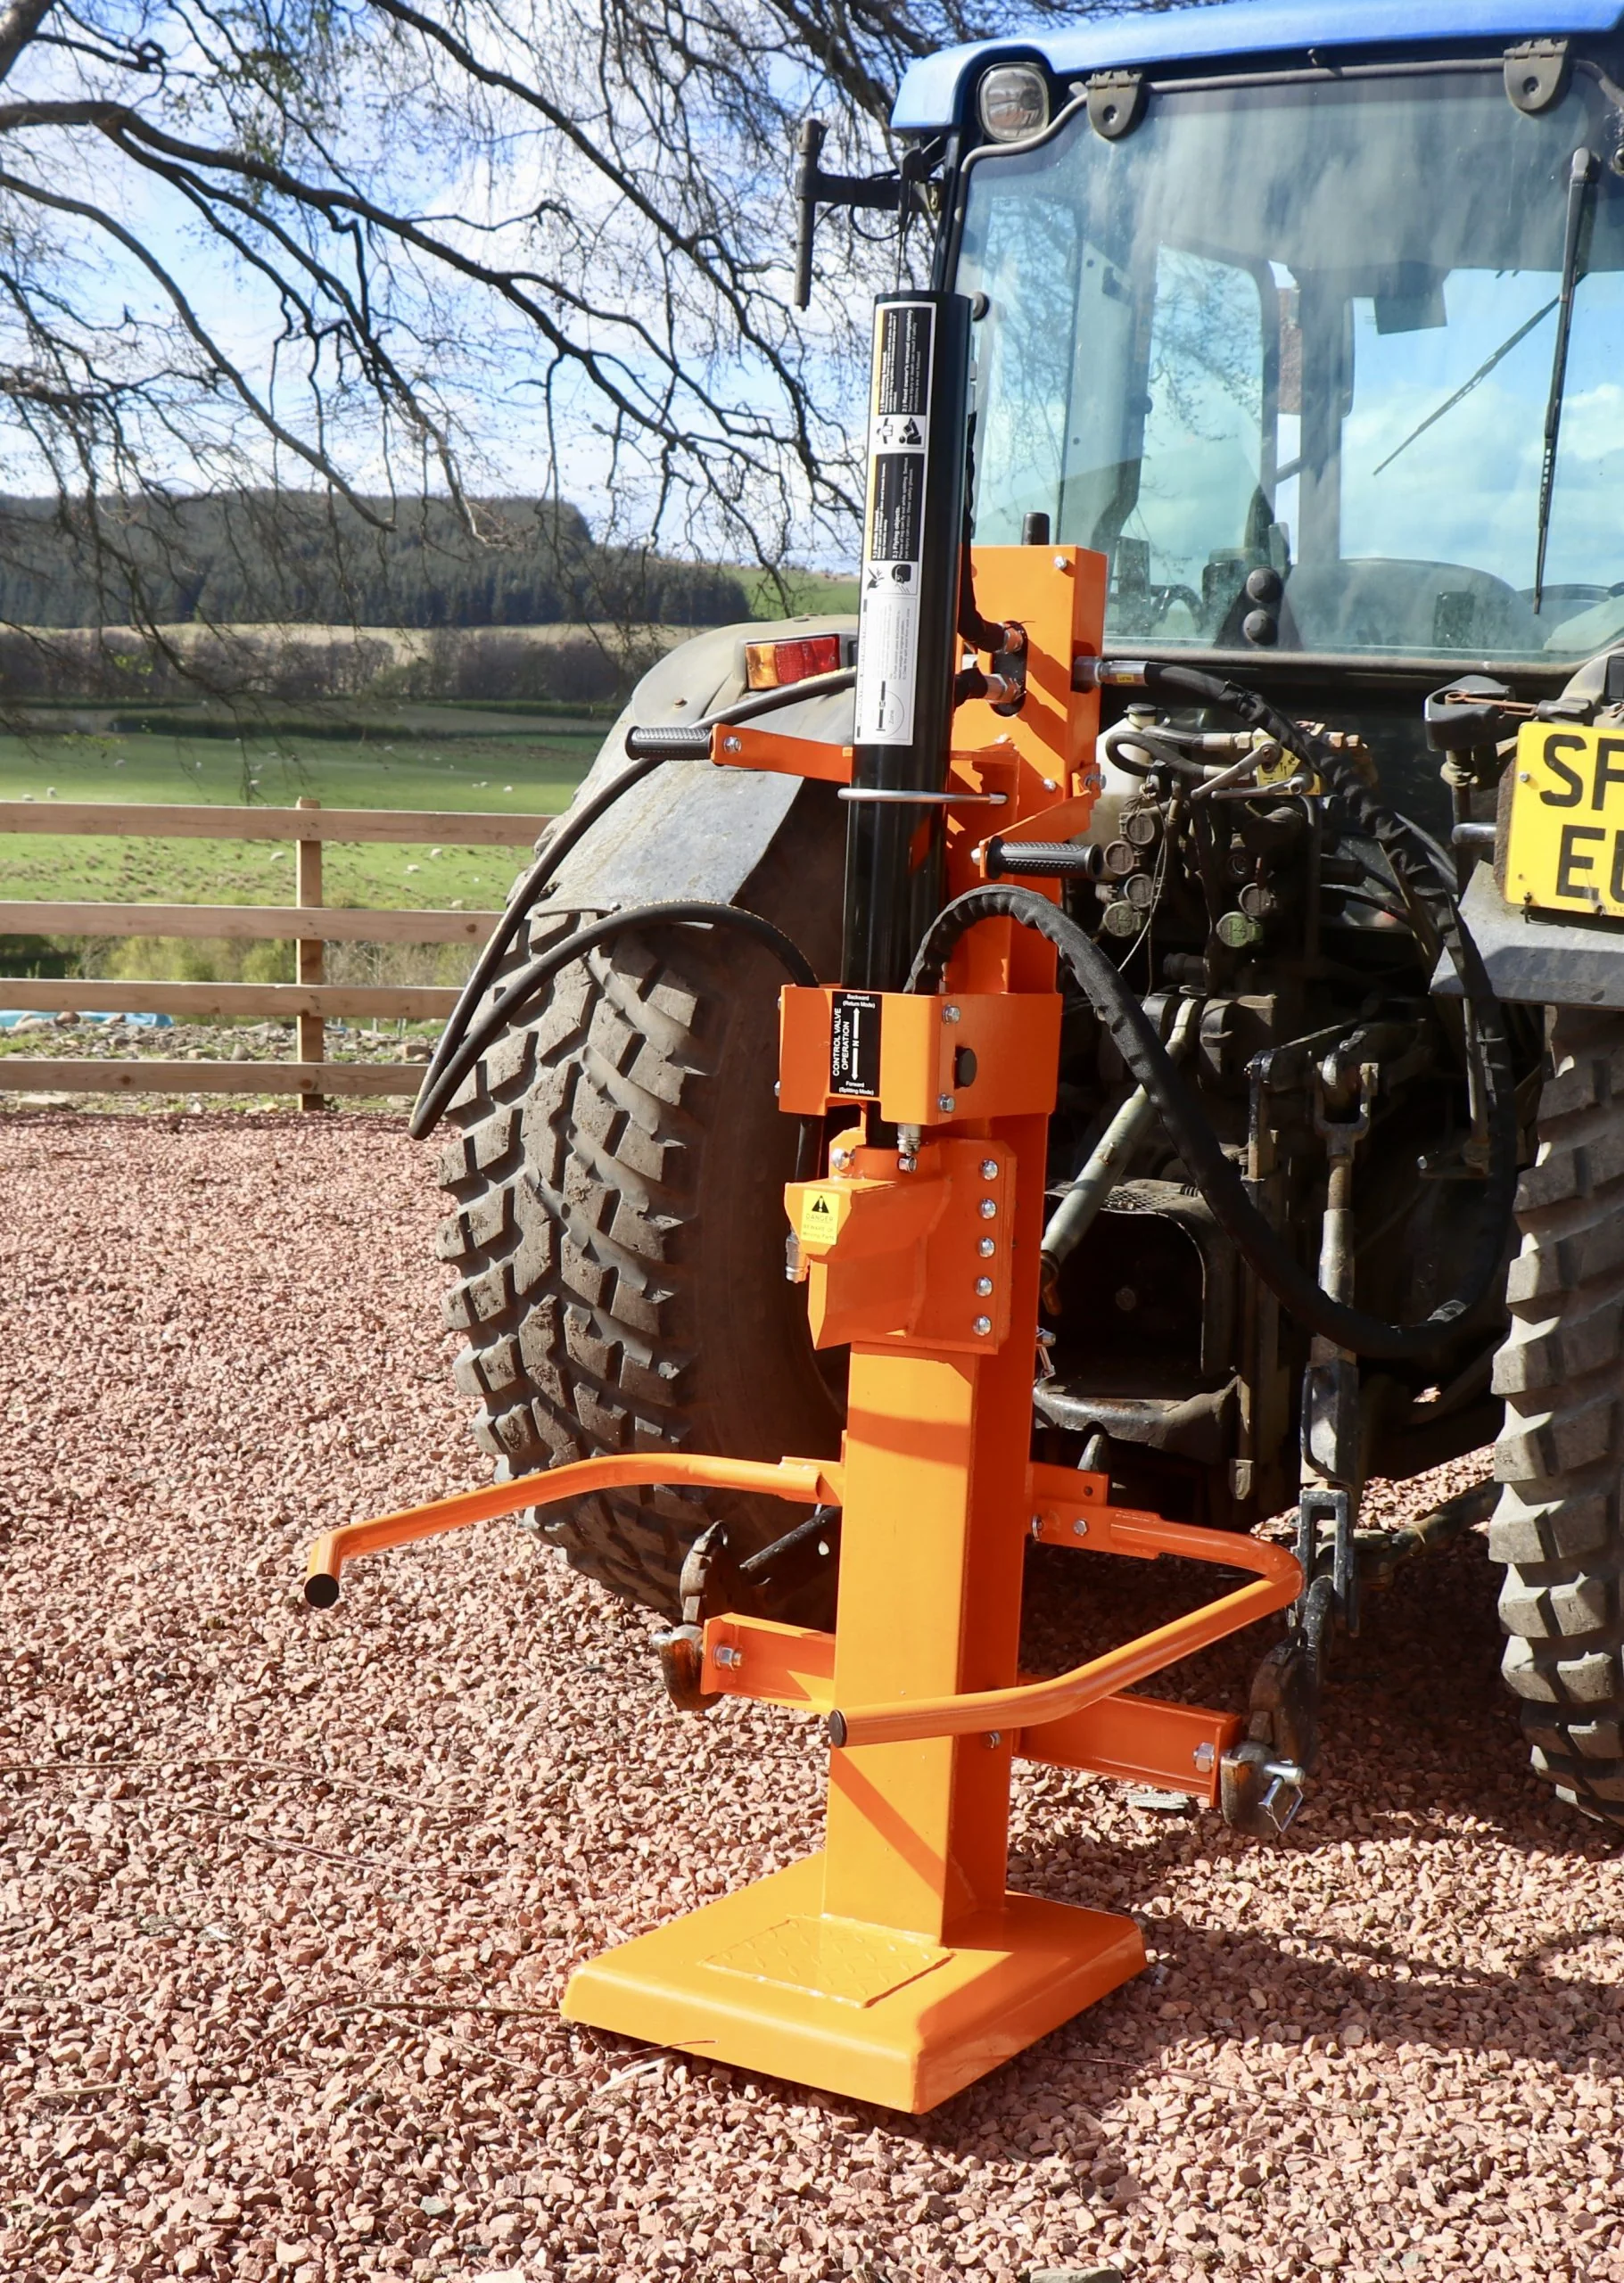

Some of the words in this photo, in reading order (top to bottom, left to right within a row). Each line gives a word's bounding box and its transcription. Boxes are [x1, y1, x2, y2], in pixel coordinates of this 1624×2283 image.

[834, 1008, 842, 1034] VALVE
[832, 1035, 841, 1076] CONTROL
[841, 1021, 850, 1070] OPERATION
